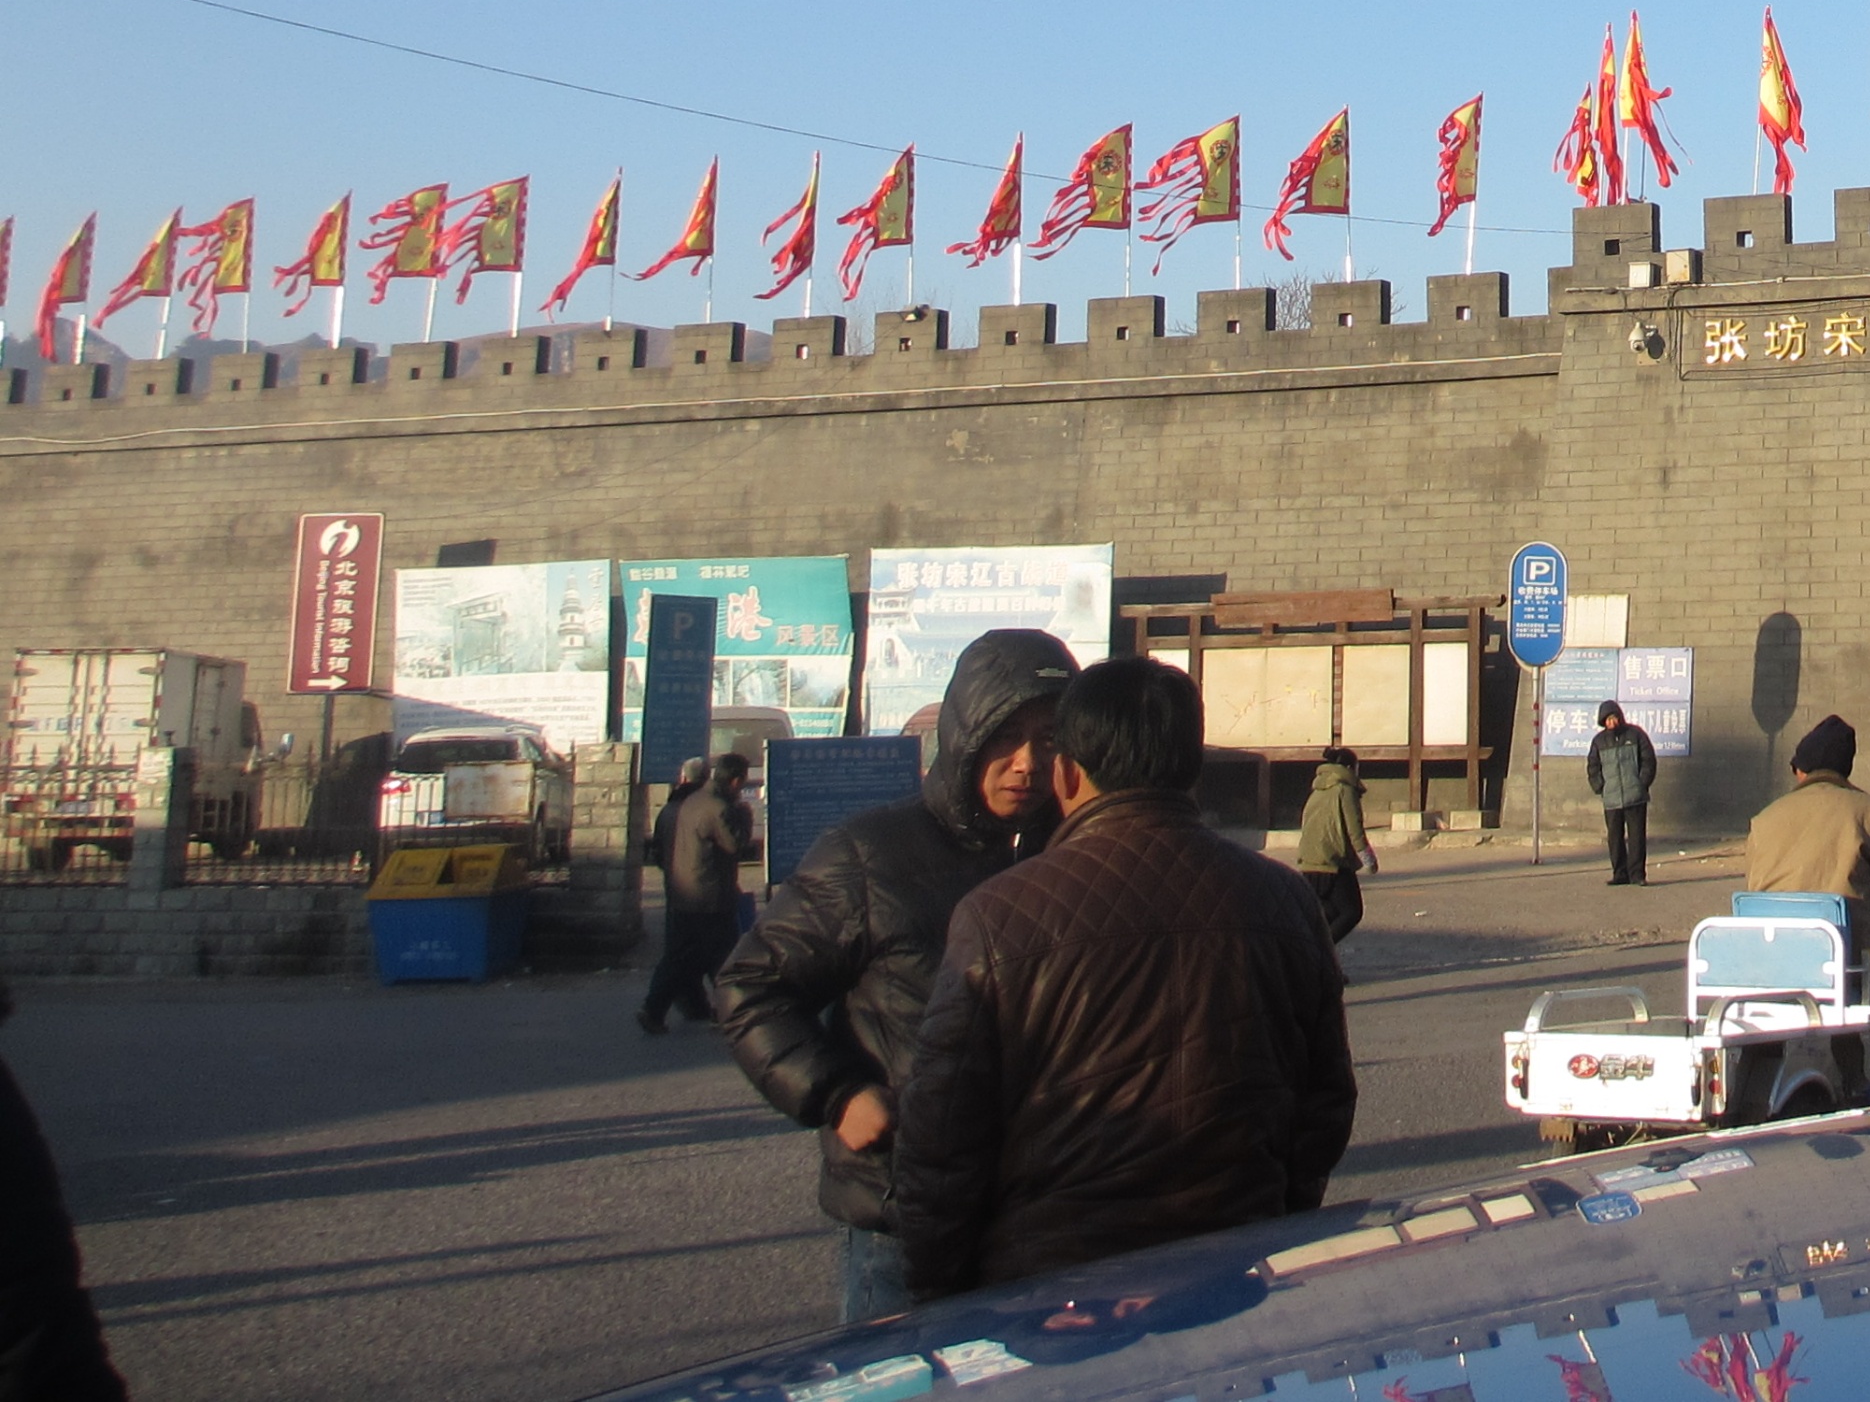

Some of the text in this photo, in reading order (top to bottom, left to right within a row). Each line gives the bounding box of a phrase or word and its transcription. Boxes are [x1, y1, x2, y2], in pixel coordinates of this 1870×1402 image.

[1529, 561, 1551, 581] P
[326, 560, 359, 674] 北京旅游咨询
[775, 624, 840, 647] 风景区
[1623, 655, 1687, 681] 售票口
[1629, 685, 1680, 696] Ticket Office
